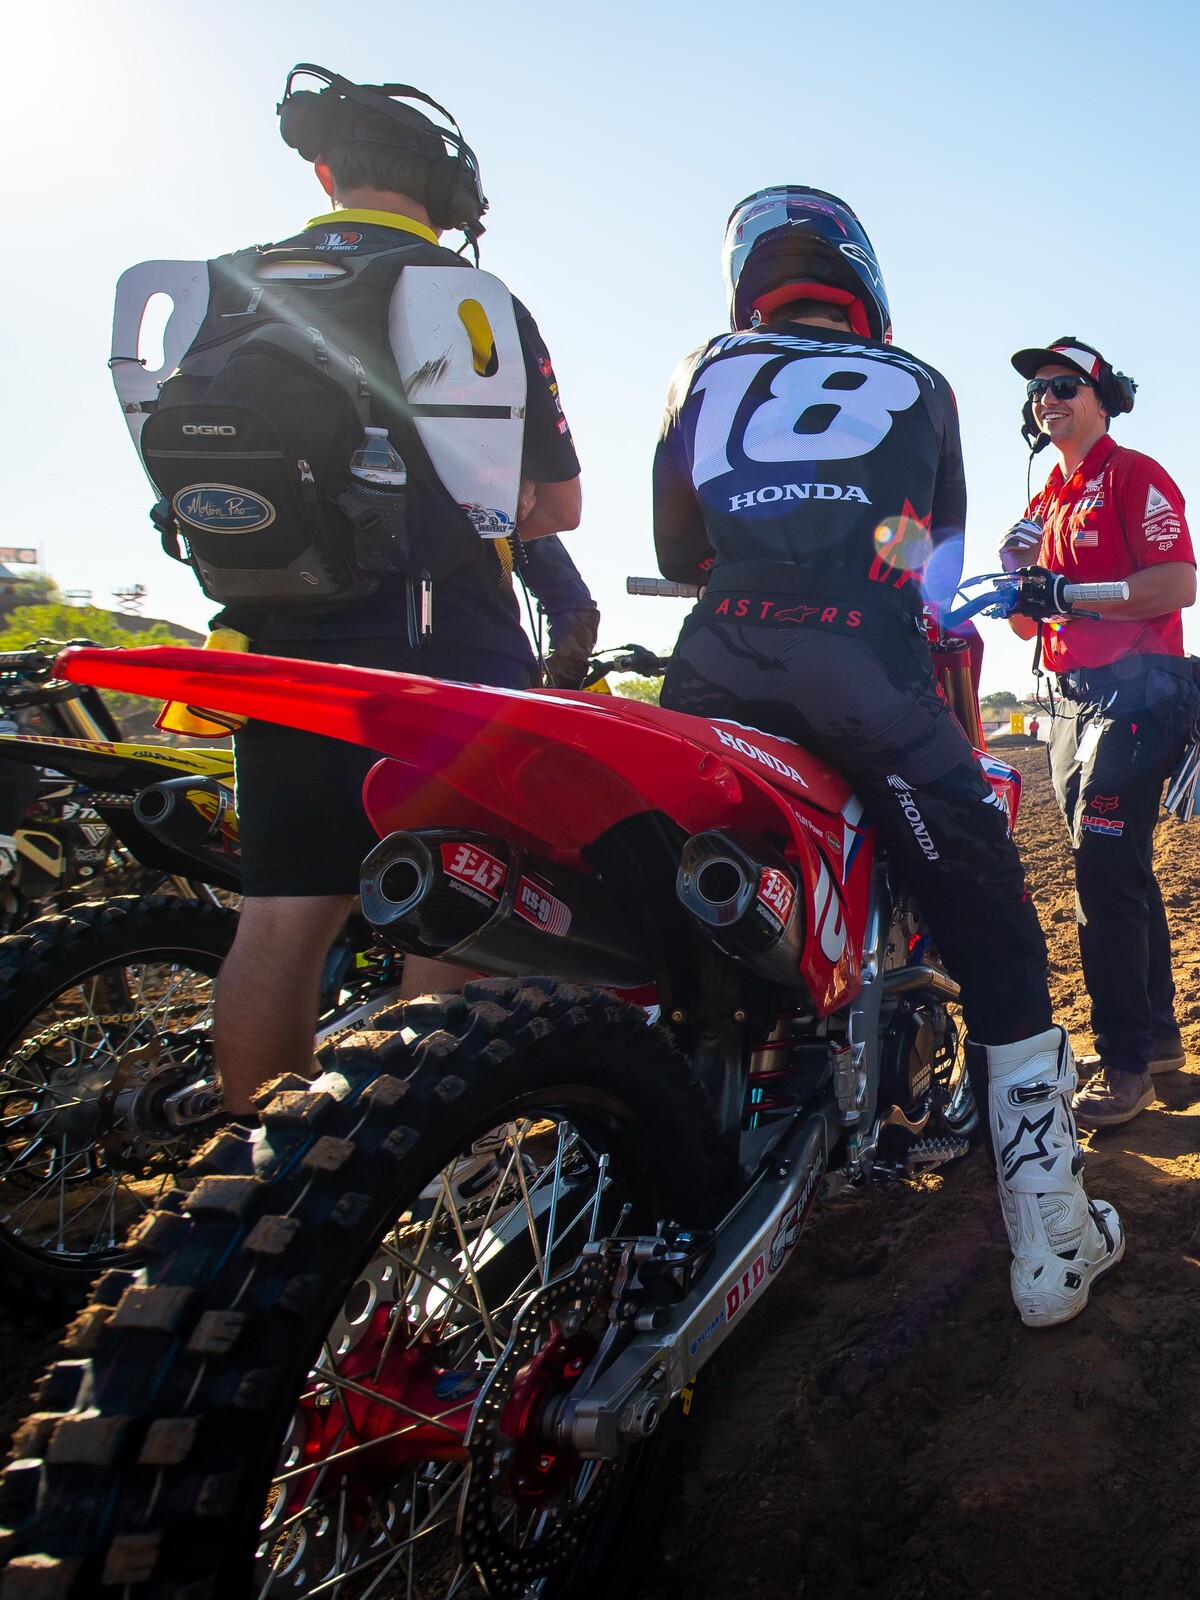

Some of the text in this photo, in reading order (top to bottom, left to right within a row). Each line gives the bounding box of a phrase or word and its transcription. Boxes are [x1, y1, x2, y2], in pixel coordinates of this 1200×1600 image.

[182, 424, 237, 435] OGIO
[691, 353, 922, 492] 18
[187, 492, 250, 518] Motion Pro
[728, 483, 873, 513] HONDA
[710, 726, 810, 788] HONDA
[894, 792, 941, 861] HONDA
[1082, 815, 1124, 836] HRC
[450, 846, 503, 890] ヨシムラ
[762, 872, 792, 914] ヨシムラ
[697, 1310, 725, 1343] YUTAKA
